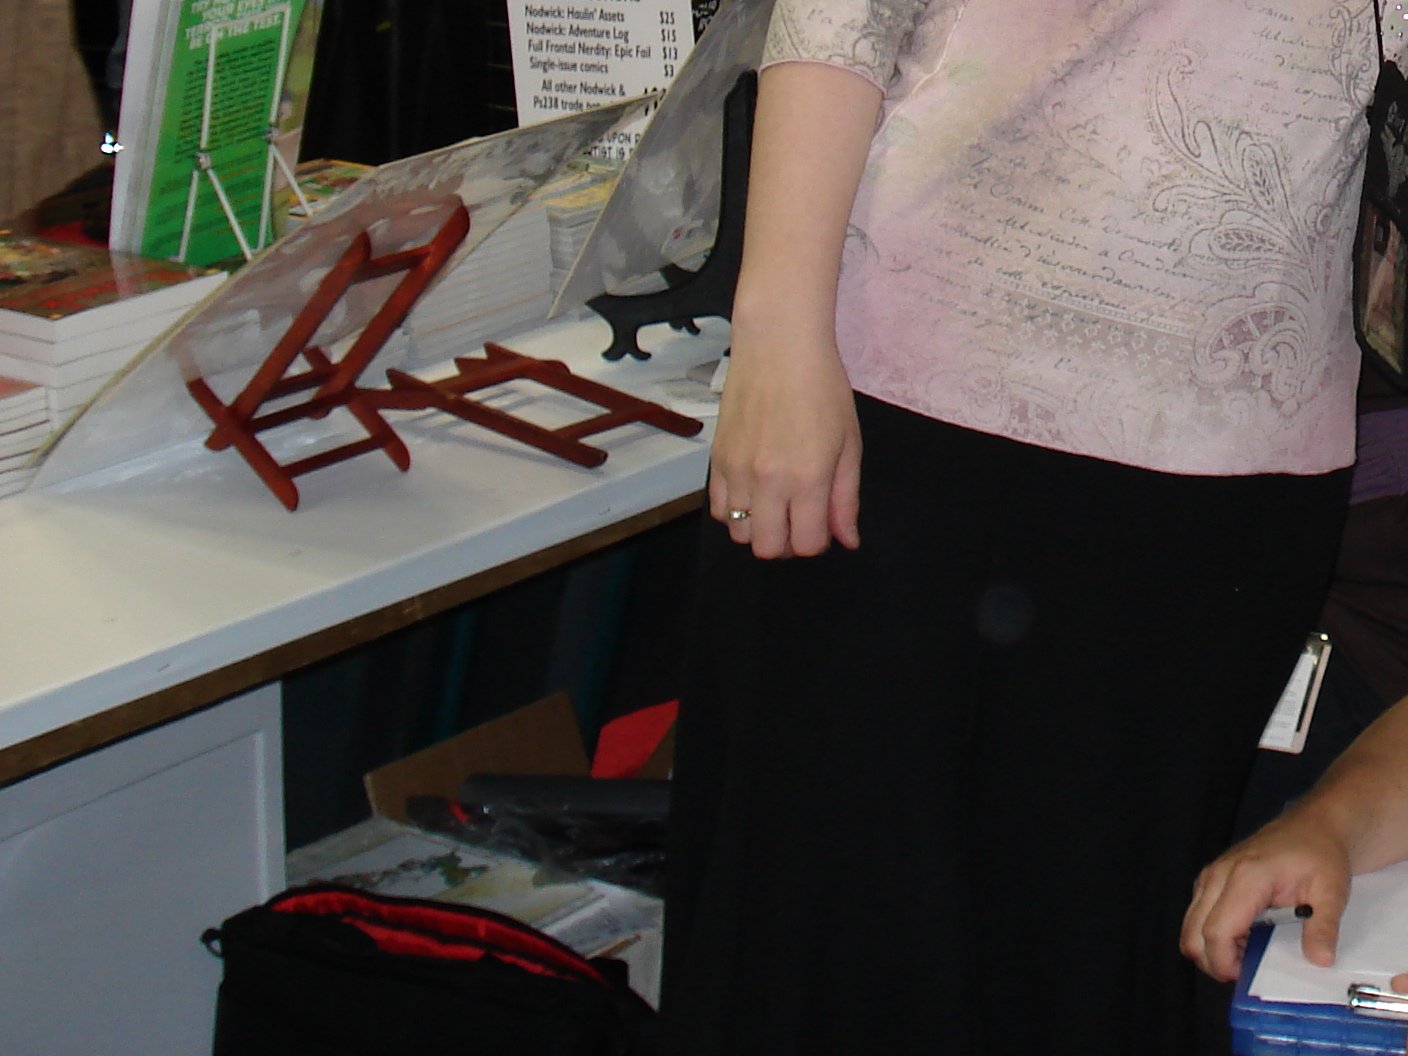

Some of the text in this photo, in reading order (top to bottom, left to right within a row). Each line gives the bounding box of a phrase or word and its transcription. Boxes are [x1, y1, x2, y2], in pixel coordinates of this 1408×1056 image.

[525, 5, 675, 25] Nodwick: Haulin' Assets $25
[526, 22, 677, 43] Nodwick: Adventure Log $15
[528, 39, 678, 62] Full Frontal Nerdity: Epic Fail $13
[529, 56, 674, 78] Single-issue comics $3
[541, 79, 626, 97] All other Nodwick &
[533, 95, 559, 110] Ps238
[561, 97, 584, 113] trade
